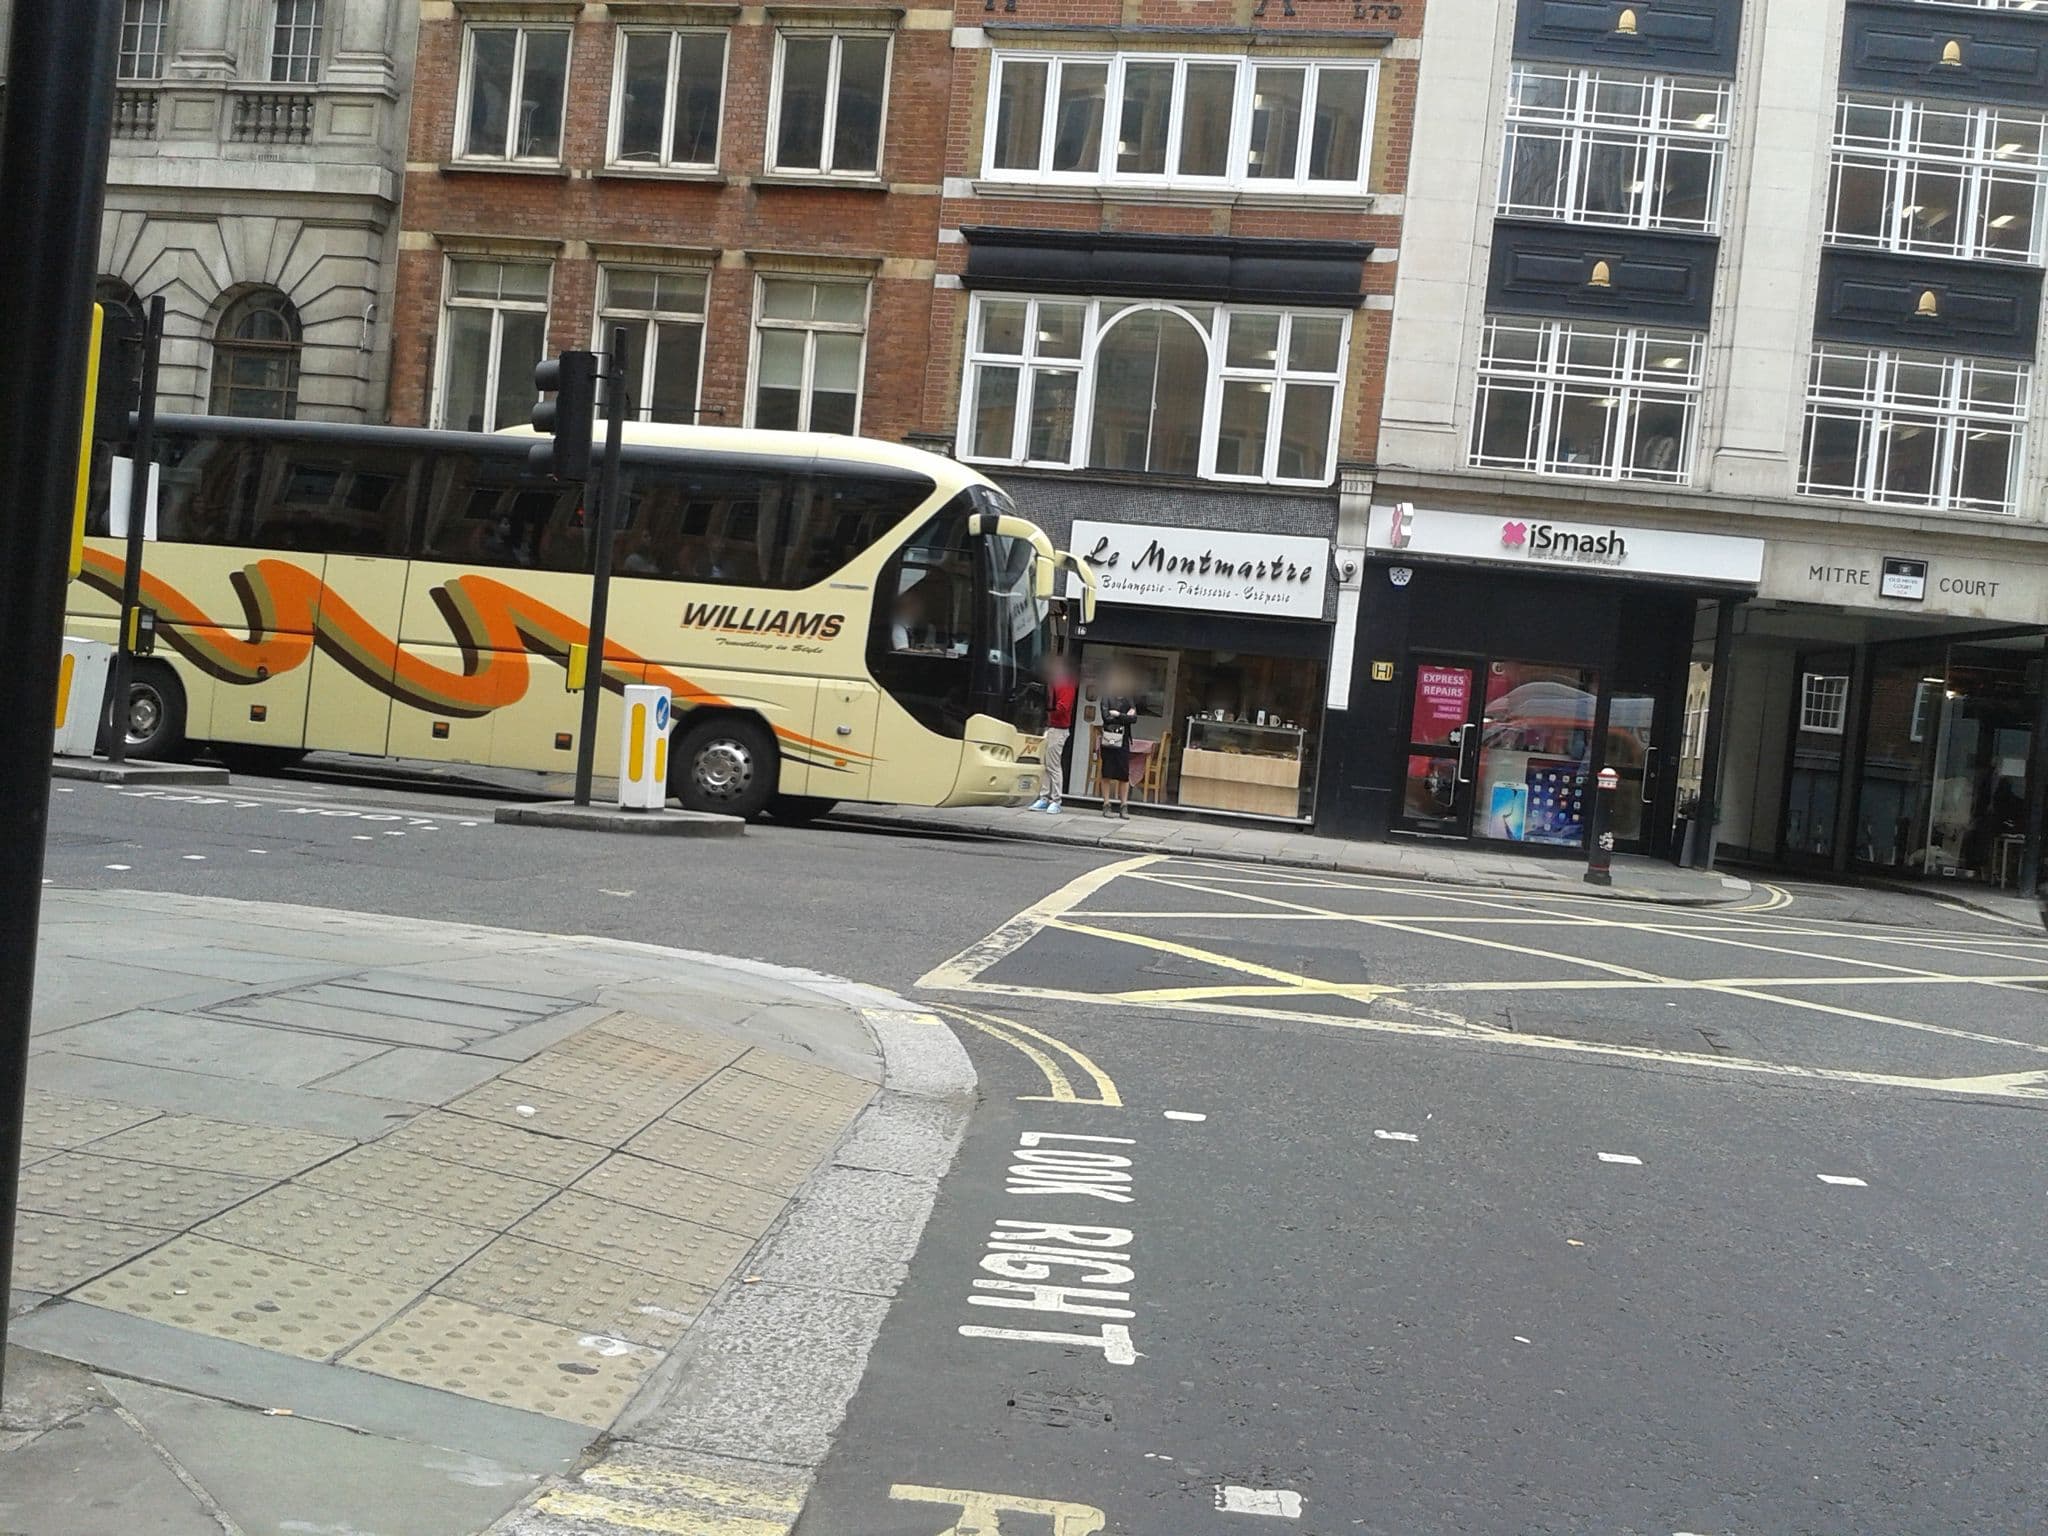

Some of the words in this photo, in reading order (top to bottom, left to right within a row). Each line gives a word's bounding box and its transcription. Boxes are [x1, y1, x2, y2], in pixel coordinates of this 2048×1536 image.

[1529, 524, 1626, 556] iSmash
[1083, 536, 1120, 567] Le
[1132, 539, 1313, 585] Montmartre
[1101, 574, 1165, 595] Boulangerie
[1808, 565, 1871, 586] MITRE
[1939, 577, 2001, 598] COURT
[681, 602, 846, 640] WILLIAMS
[1423, 673, 1464, 686] EXPRESS
[1423, 685, 1464, 698] REPAIRS
[1005, 1131, 1137, 1203] LOOK
[958, 1219, 1137, 1366] RIGHT
